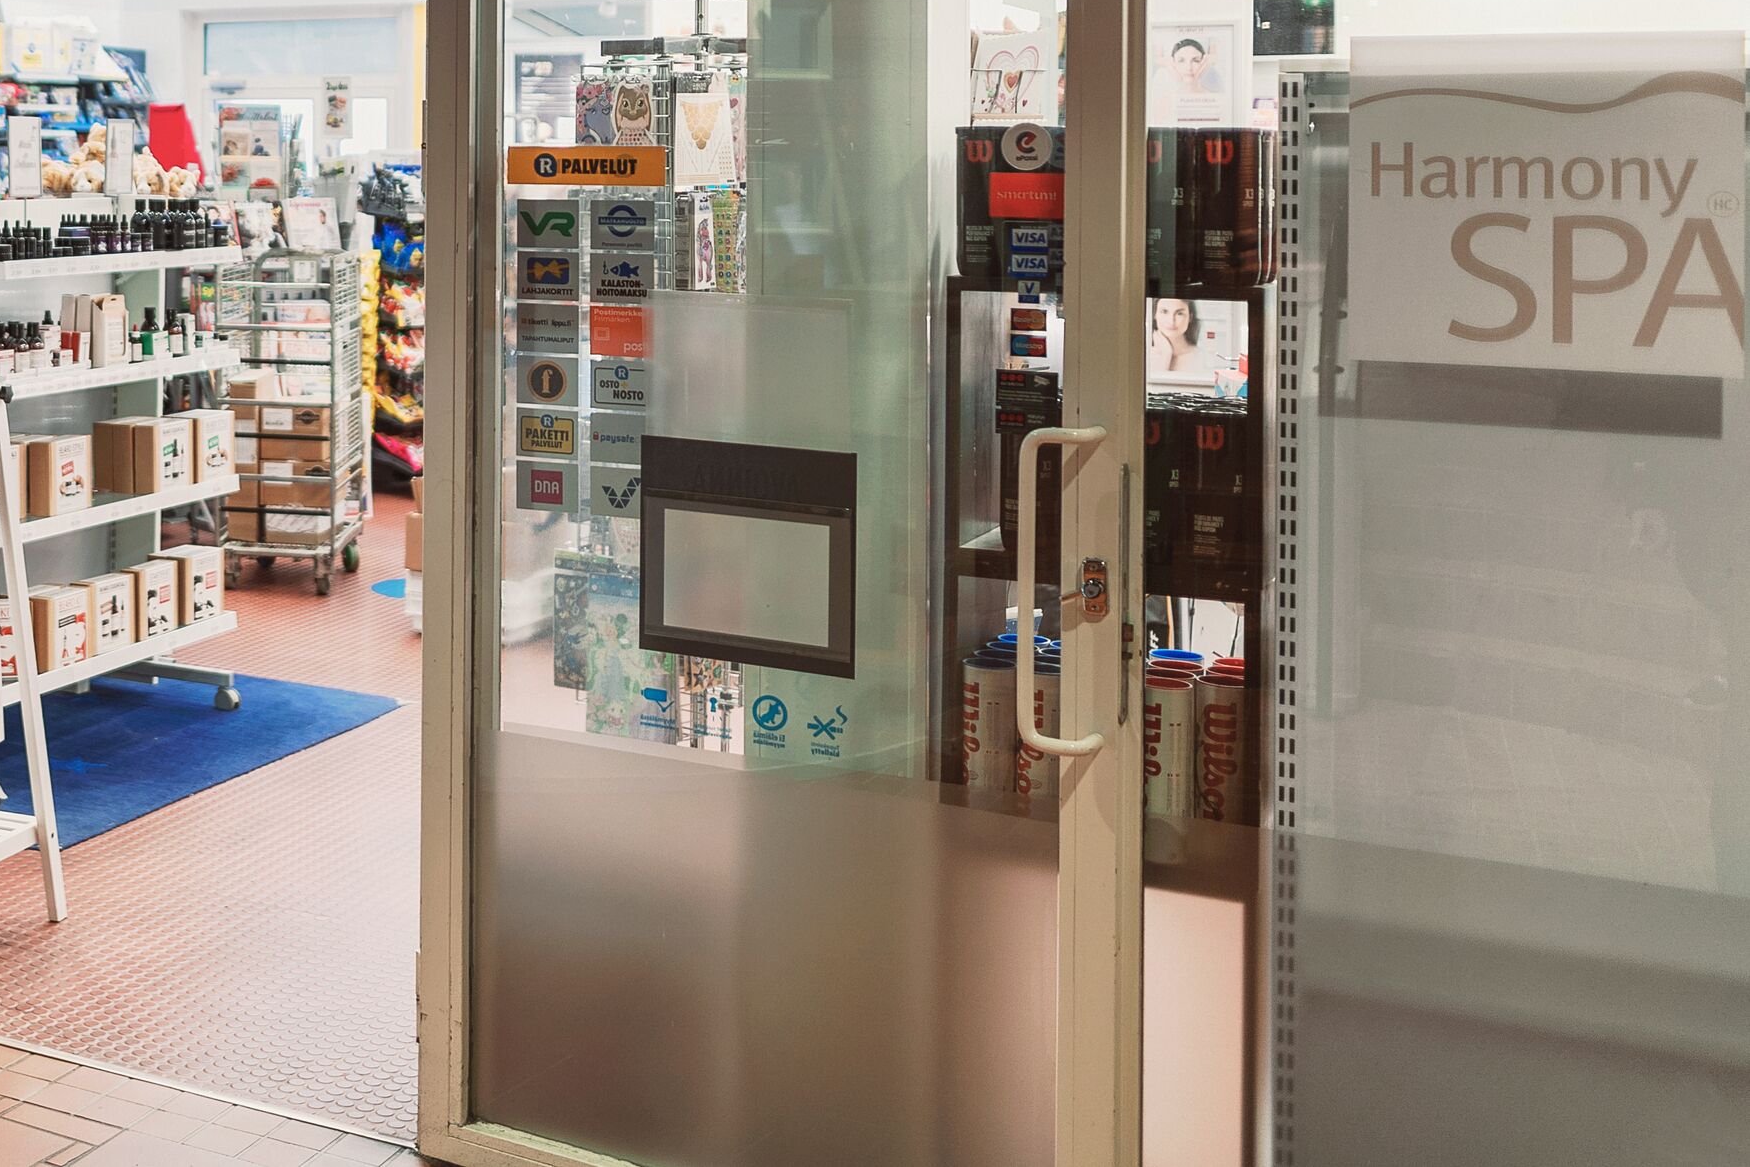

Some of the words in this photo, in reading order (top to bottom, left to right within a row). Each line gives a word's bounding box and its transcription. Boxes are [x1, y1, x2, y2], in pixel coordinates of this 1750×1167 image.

[561, 158, 638, 175] PALVELUT
[1370, 141, 1699, 218] Harmony
[519, 210, 575, 237] VR
[1015, 232, 1046, 244] VISA
[1015, 257, 1046, 269] VISA
[600, 279, 644, 288] KALASTON-
[1447, 211, 1746, 350] SPA
[521, 287, 574, 296] LAHJAKORTIT
[596, 288, 648, 298] HOITOMAKSU
[521, 335, 575, 344] TAPAHTUMALIPUT
[623, 342, 643, 353] pos
[599, 379, 620, 388] OSTO
[612, 390, 644, 401] NOSTO
[525, 427, 569, 441] PAKETTI
[530, 439, 563, 449] PALVELUT
